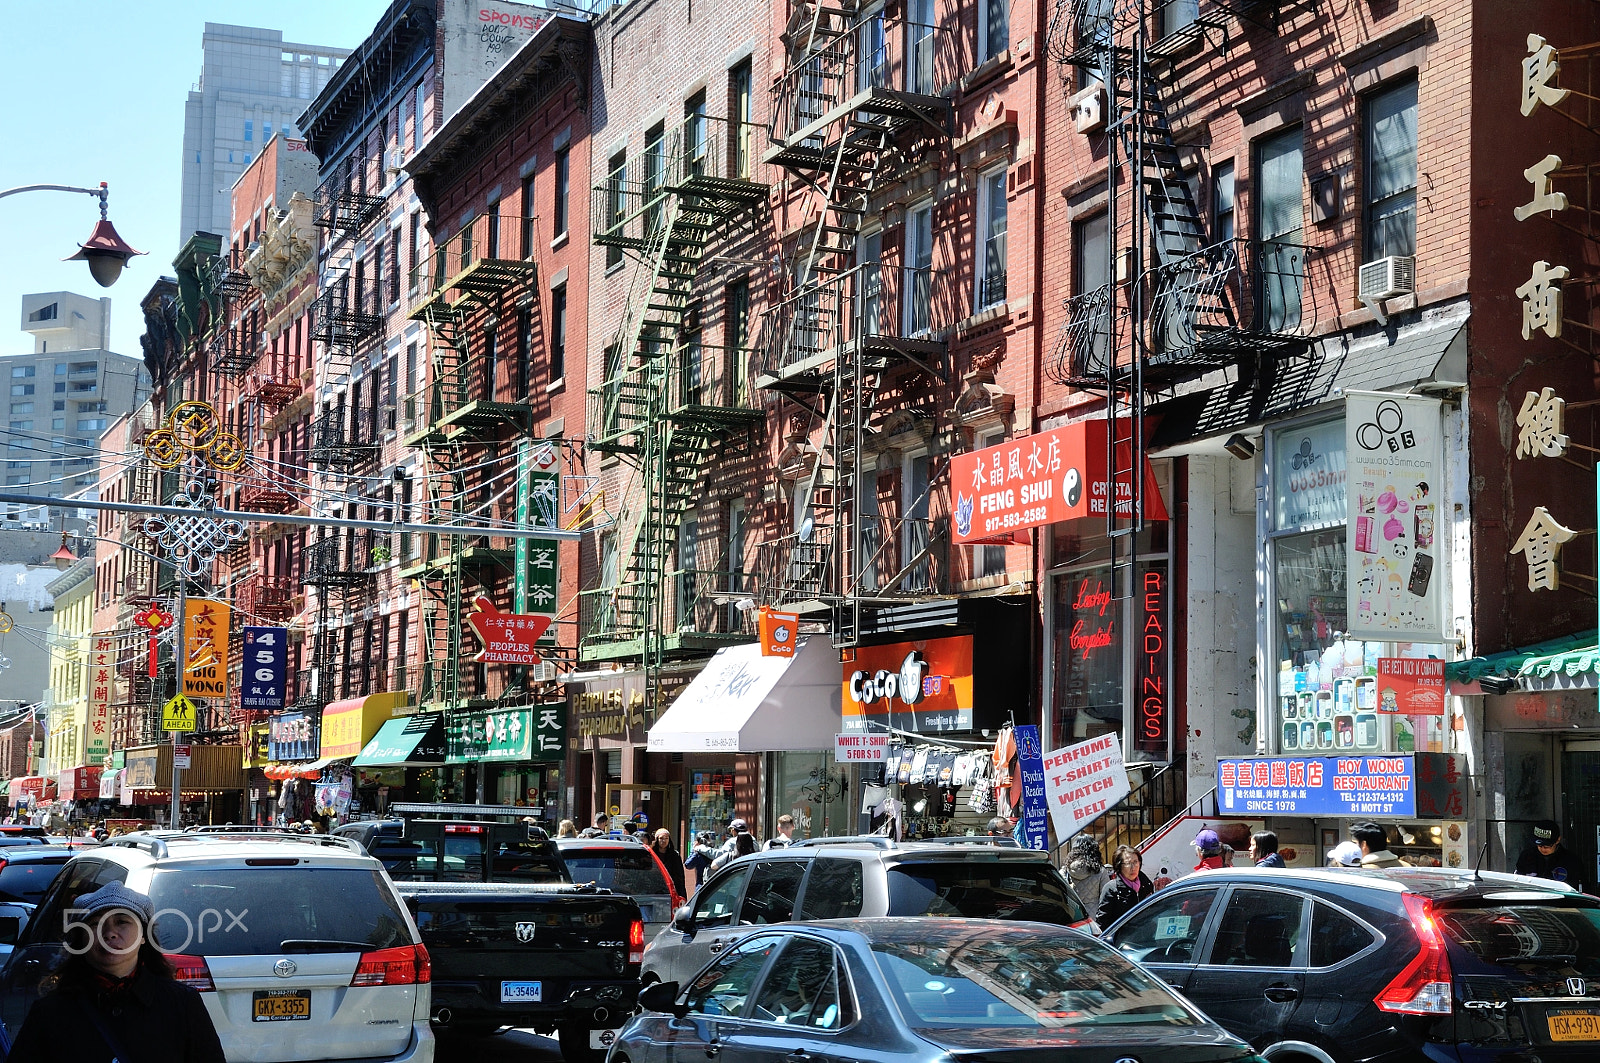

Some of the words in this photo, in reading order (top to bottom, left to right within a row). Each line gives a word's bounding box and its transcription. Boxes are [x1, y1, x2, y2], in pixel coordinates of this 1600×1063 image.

[972, 434, 1061, 492] 水晶風水店
[980, 489, 1014, 514] FENG
[1020, 479, 1053, 503] SHUI
[985, 506, 1047, 532] 917-583-2582
[490, 641, 530, 653] PEOPLES
[771, 644, 791, 653] CoCo
[484, 652, 535, 663] PHARMACY
[1143, 572, 1162, 738] READINGS
[192, 666, 217, 679] BIG
[1381, 660, 1390, 675] THE
[1391, 660, 1403, 675] BEST
[185, 680, 224, 694] WONG
[849, 669, 897, 705] CoCo
[572, 688, 622, 714] PEOPLES
[166, 720, 192, 729] AHEAD
[537, 709, 562, 752] 天仁
[579, 714, 627, 736] PHARMACY
[838, 736, 860, 747] WHITE
[869, 736, 889, 747] SHIRT
[847, 749, 852, 759] 5
[853, 749, 866, 759] FOR
[873, 749, 881, 759] 10
[1043, 737, 1113, 771] PERFUME
[1052, 757, 1111, 788] T-SHIRT
[1338, 760, 1362, 774] HOY
[1367, 759, 1405, 774] WONG
[1023, 769, 1043, 784] Psychic
[1333, 775, 1410, 791] RESTAURANT
[1024, 784, 1044, 798] Reader
[1058, 777, 1114, 806] WATCH
[1340, 793, 1356, 802] TEL:
[1357, 793, 1404, 803] 212-374-1312
[1026, 805, 1046, 819] Advisor
[1073, 798, 1107, 821] BELT
[1246, 801, 1273, 811] SINCE
[1275, 801, 1296, 811] 1978
[1350, 803, 1360, 812] 81
[1361, 803, 1381, 812] MOTT
[1383, 803, 1393, 812] ST
[1033, 835, 1043, 850] 5
[1463, 1001, 1508, 1009] CR-V
